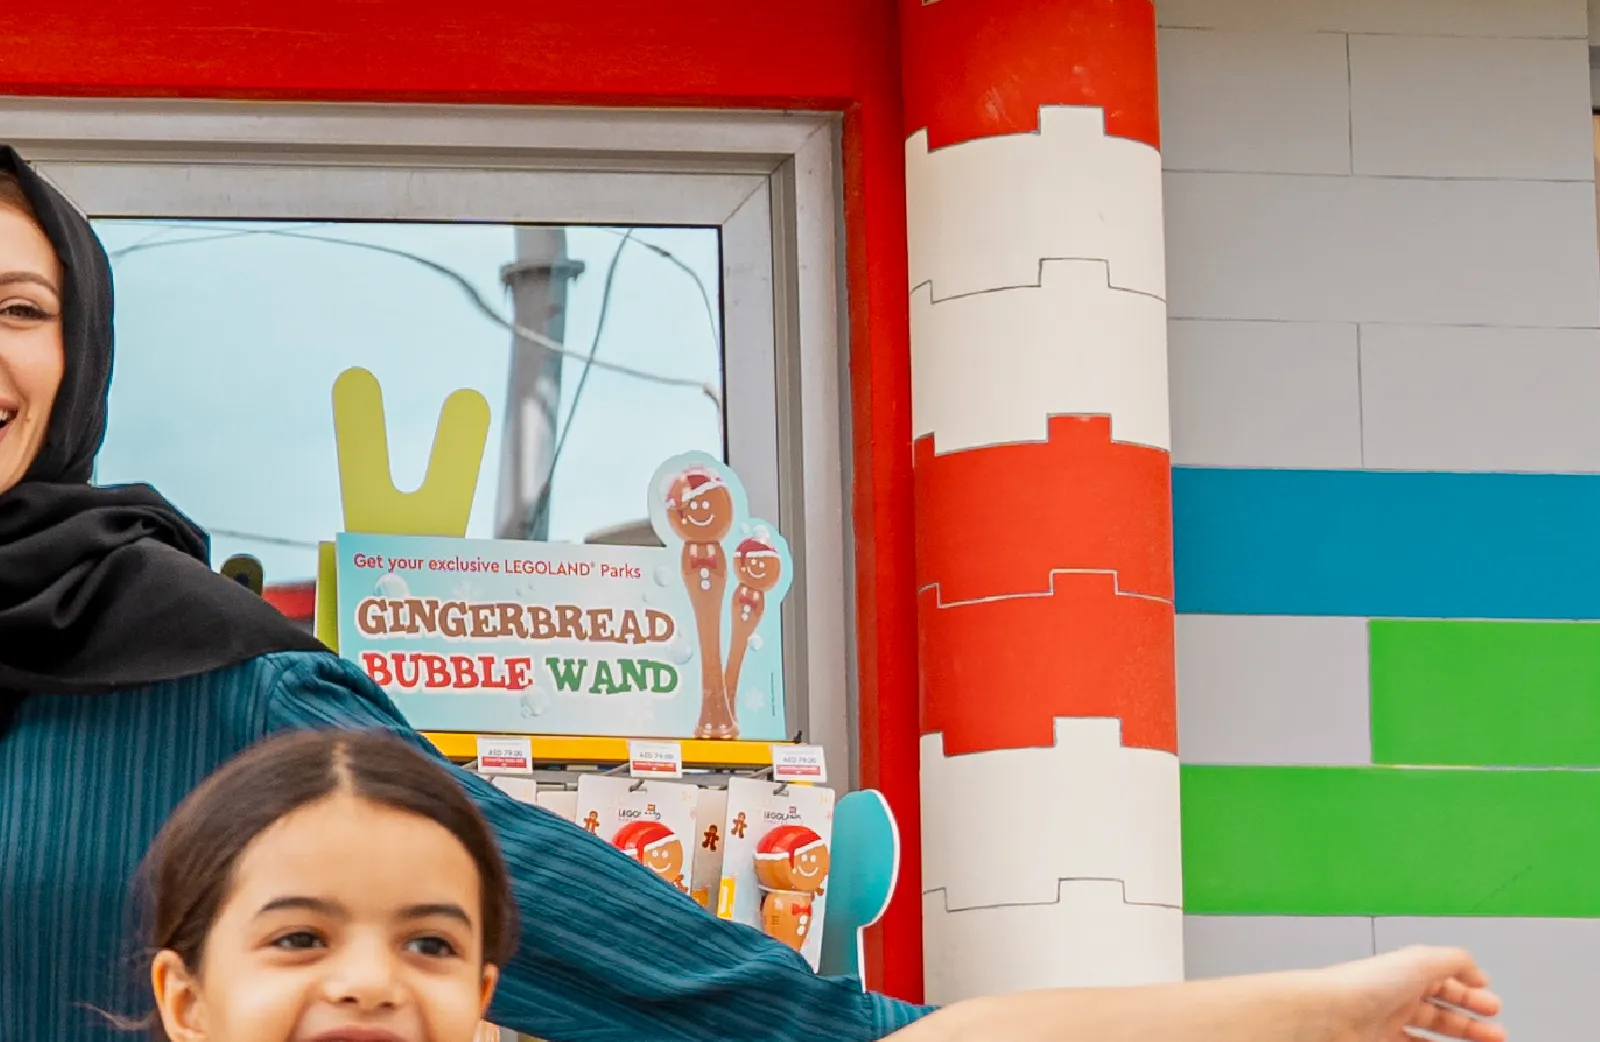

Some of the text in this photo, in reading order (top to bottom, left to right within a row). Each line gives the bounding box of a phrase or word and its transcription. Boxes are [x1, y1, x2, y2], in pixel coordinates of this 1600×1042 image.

[354, 553, 383, 570] Get
[387, 556, 423, 574] your
[429, 557, 500, 573] exclusive
[601, 564, 641, 578] Parks
[358, 598, 675, 645] GINGERBREAD
[362, 653, 679, 694] BUBBLE WAND
